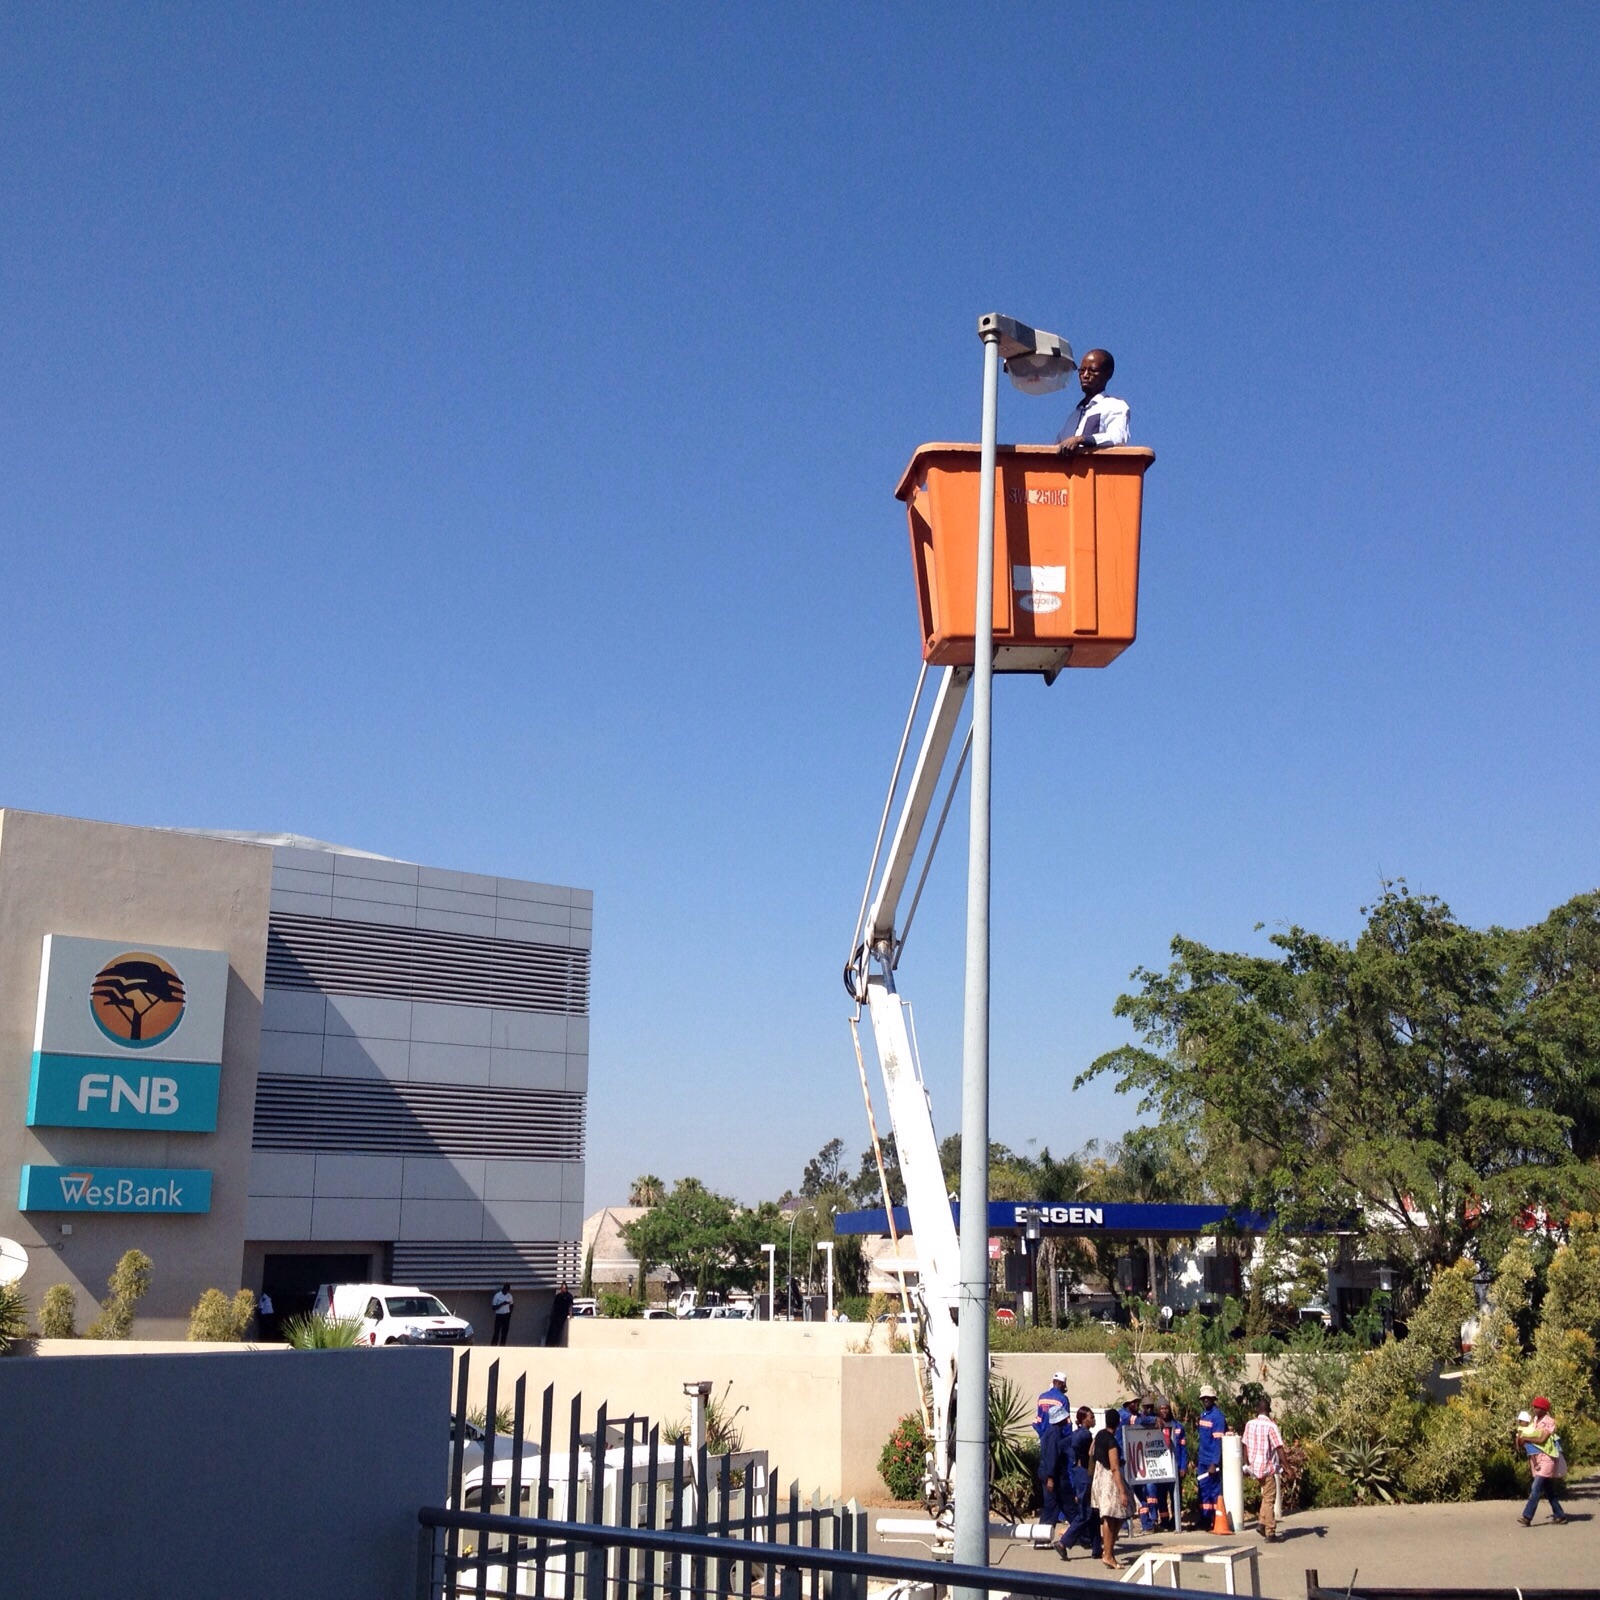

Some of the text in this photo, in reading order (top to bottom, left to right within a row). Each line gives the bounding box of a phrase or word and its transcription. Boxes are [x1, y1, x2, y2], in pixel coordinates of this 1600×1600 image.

[77, 1073, 180, 1115] FNB
[60, 1174, 183, 1206] WesBank
[1127, 1441, 1146, 1478] NO
